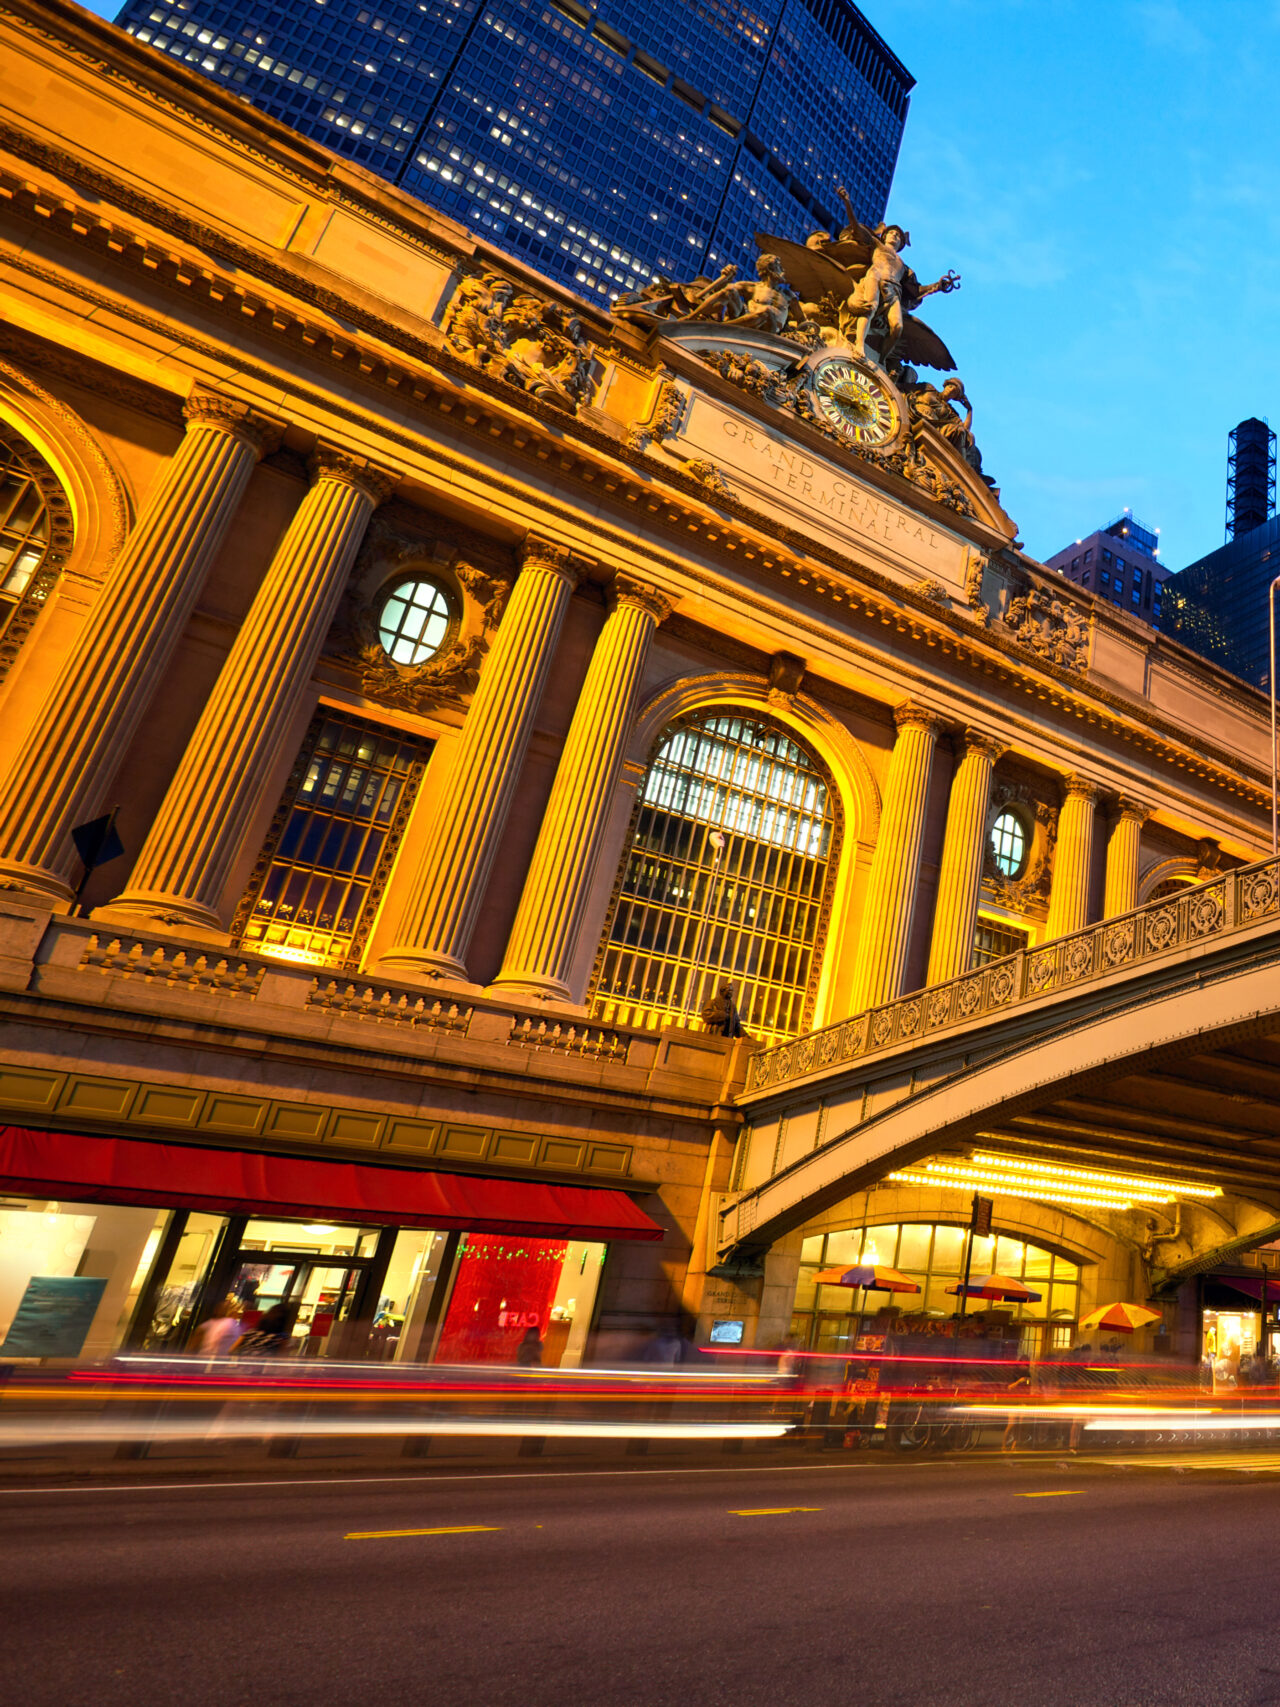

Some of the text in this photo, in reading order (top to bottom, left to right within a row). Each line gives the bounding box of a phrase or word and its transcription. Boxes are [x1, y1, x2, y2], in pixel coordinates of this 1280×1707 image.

[723, 421, 938, 549] GRAND CENTRAL
[772, 464, 893, 541] TERMINAL
